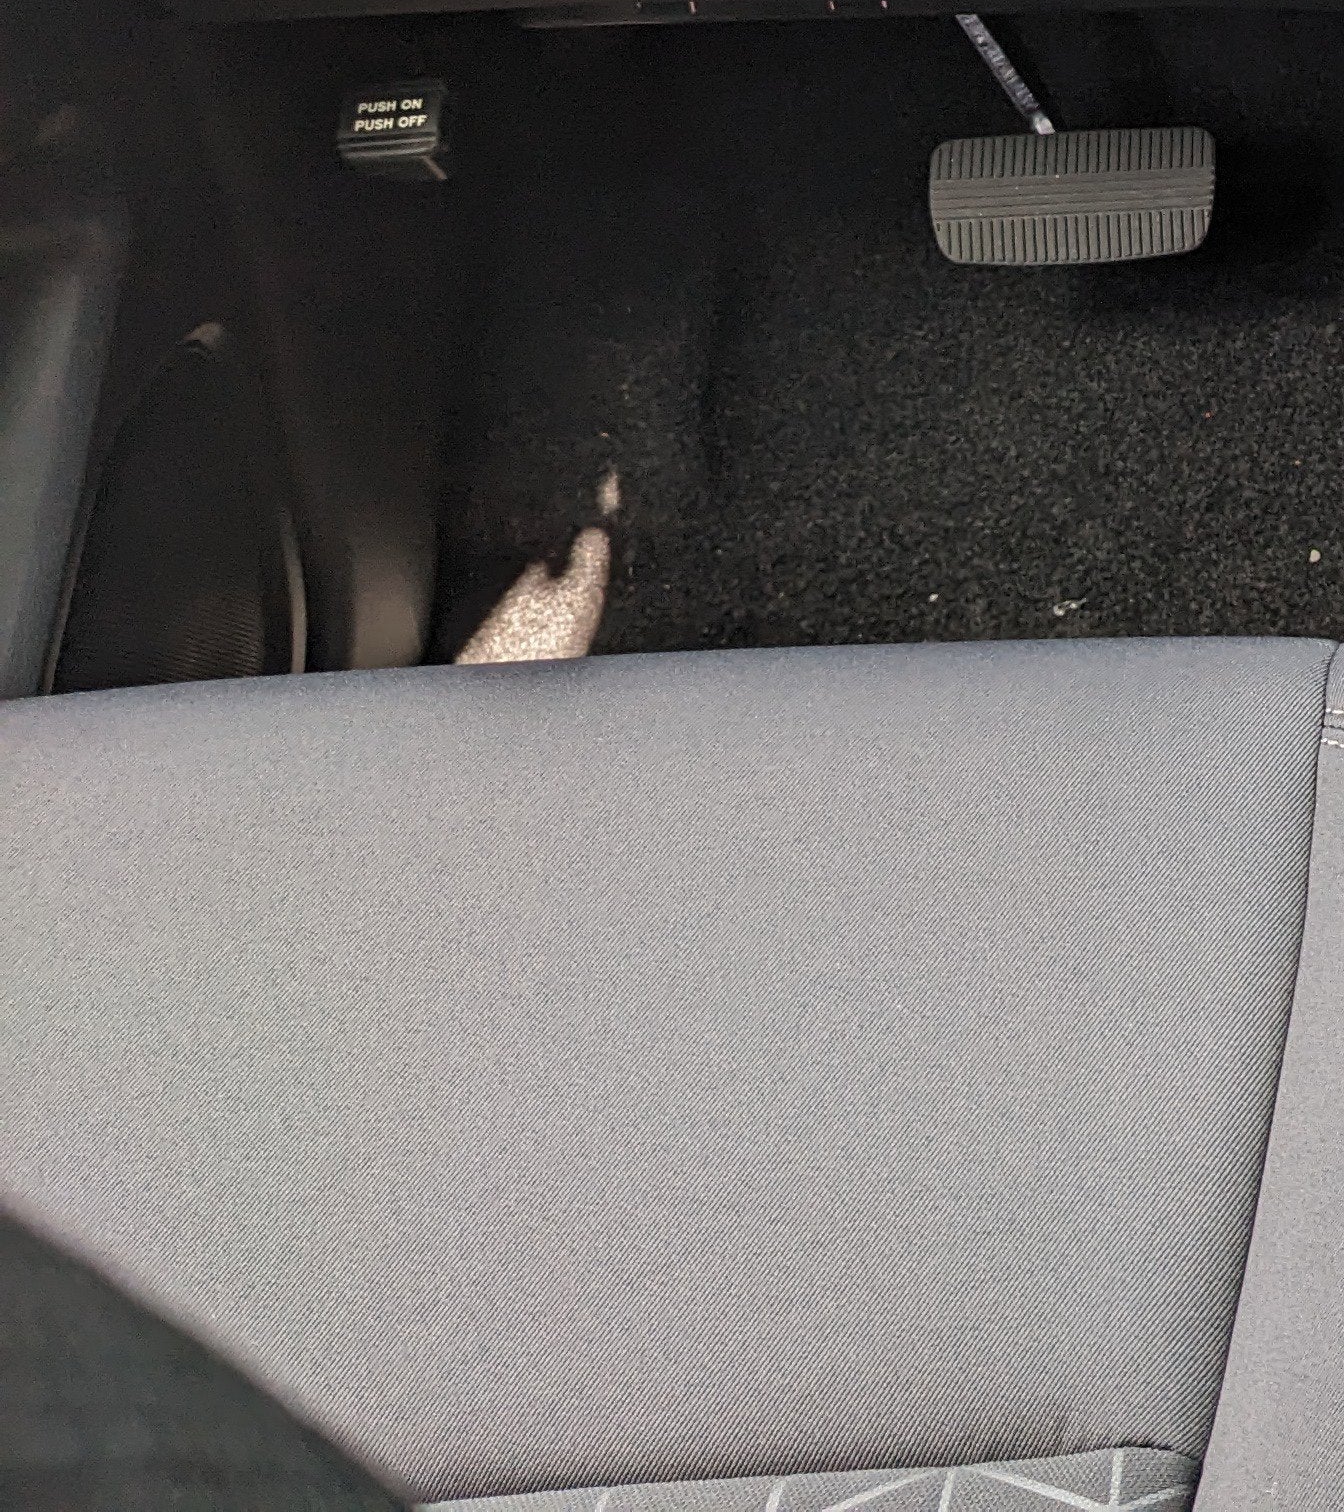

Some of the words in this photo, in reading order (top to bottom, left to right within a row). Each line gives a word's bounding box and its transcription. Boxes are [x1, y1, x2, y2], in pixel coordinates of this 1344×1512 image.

[358, 100, 397, 114] PUSH
[400, 98, 423, 110] ON
[354, 118, 395, 132] PUSH
[398, 115, 428, 128] OFF
